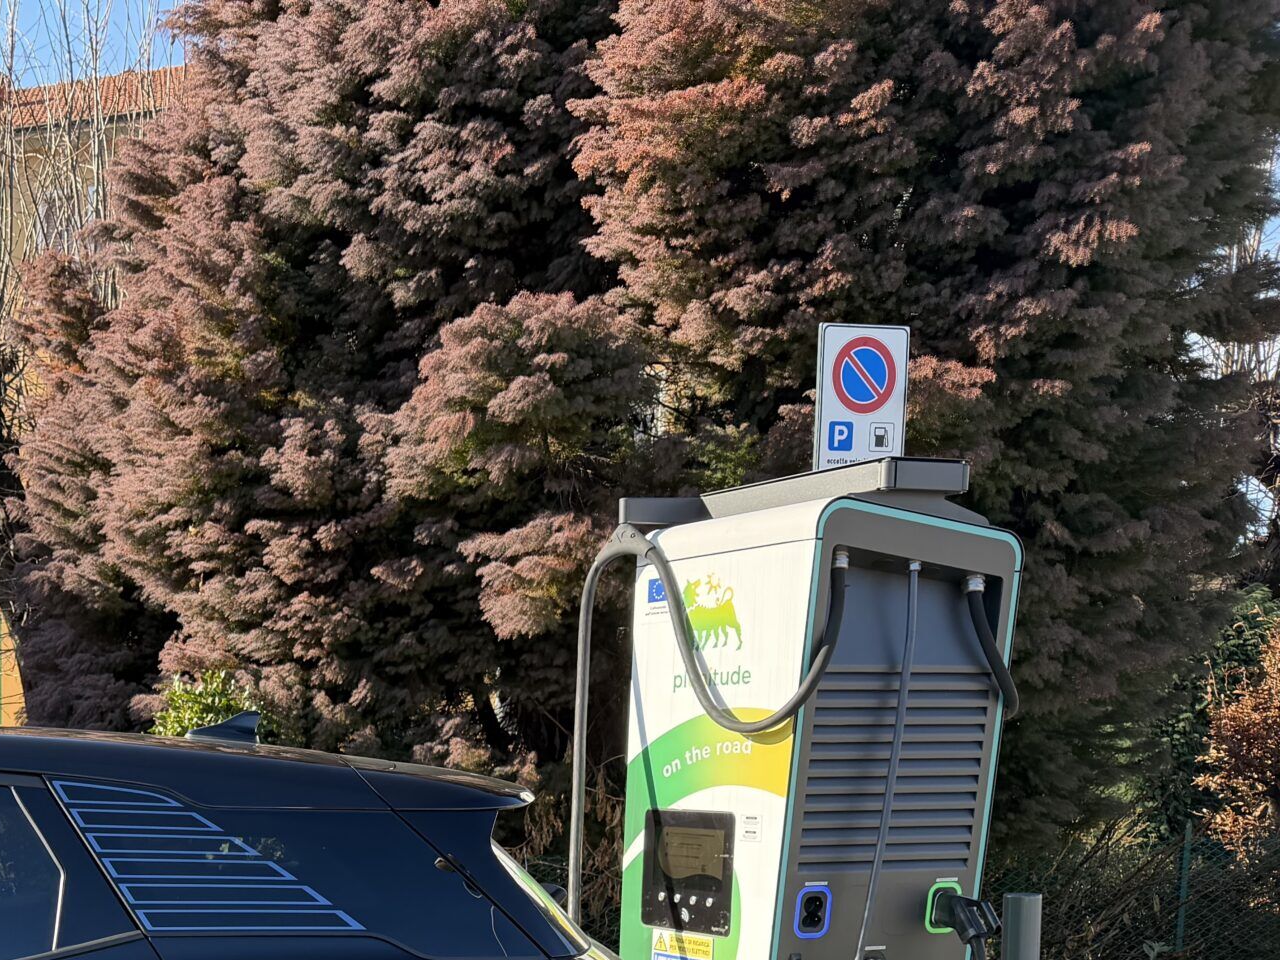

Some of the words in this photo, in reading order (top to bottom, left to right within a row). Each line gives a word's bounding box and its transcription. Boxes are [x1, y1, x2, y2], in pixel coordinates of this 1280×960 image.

[833, 425, 849, 447] P
[673, 665, 752, 693] plitude
[662, 757, 682, 778] on
[685, 744, 711, 766] the
[716, 739, 753, 755] road
